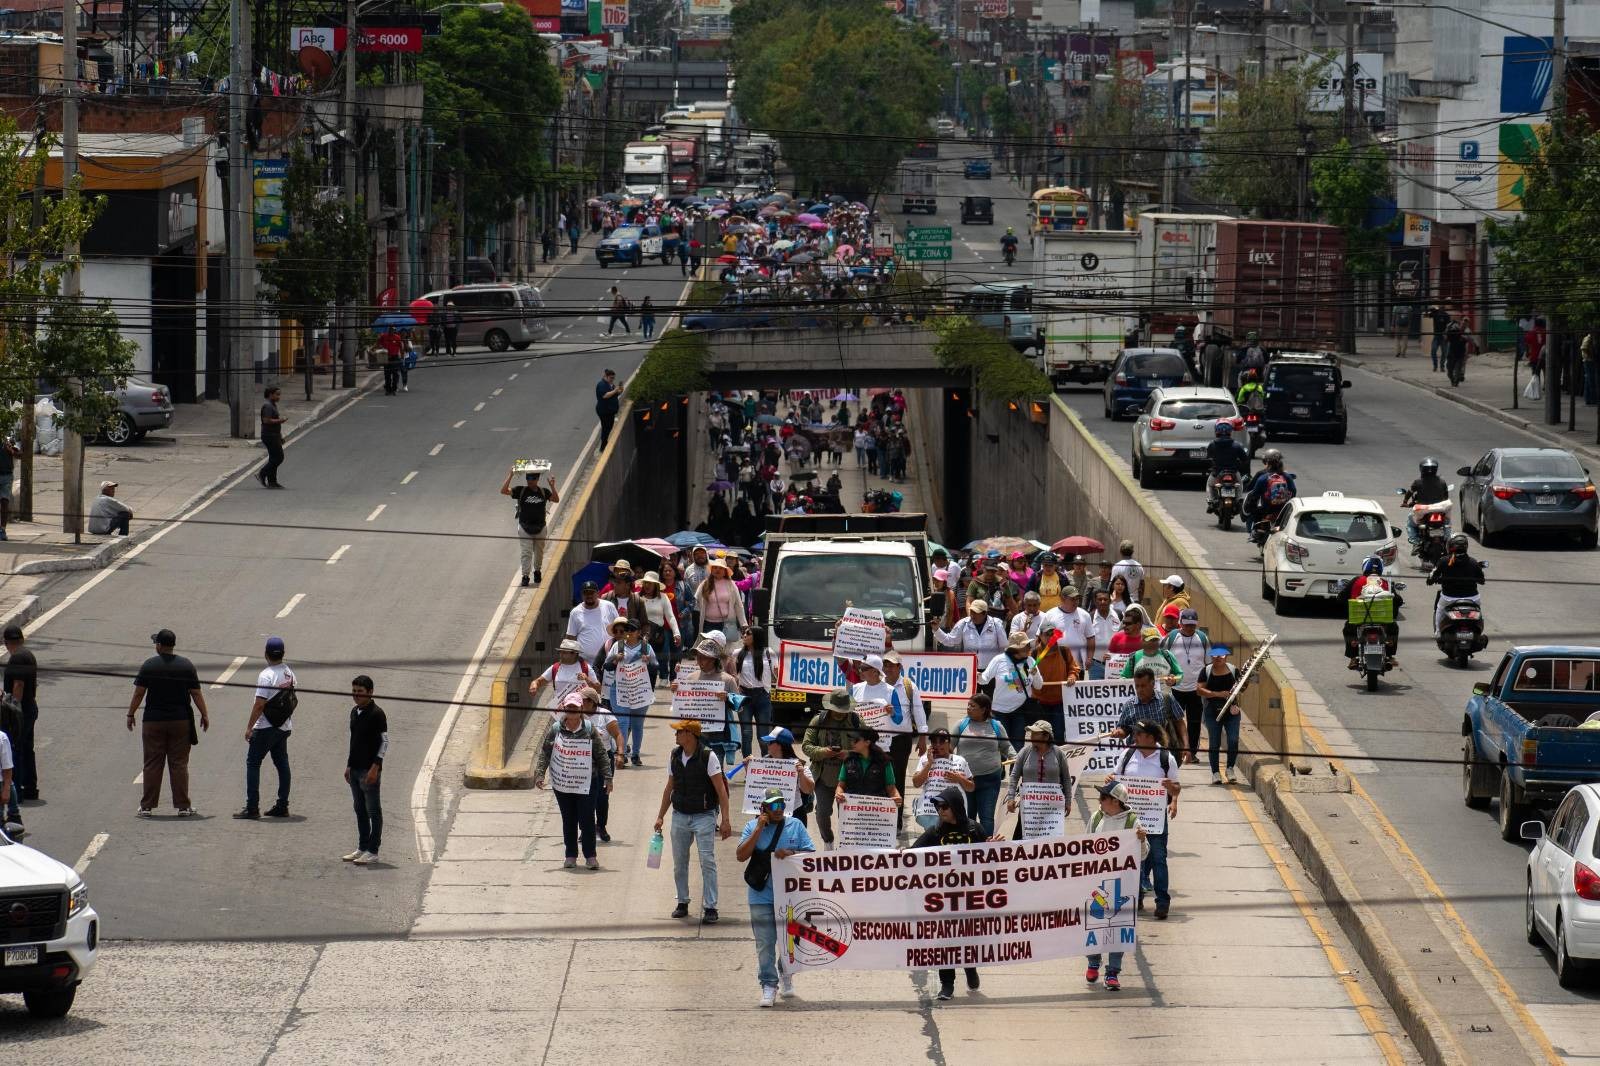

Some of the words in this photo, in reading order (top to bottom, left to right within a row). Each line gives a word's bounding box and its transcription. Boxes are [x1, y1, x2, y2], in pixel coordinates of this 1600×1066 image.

[604, 8, 626, 24] 1702
[302, 35, 325, 44] ABG
[1464, 144, 1473, 157] P
[922, 249, 941, 258] ZONA
[943, 250, 948, 258] 6
[790, 651, 830, 686] Hasta
[908, 661, 968, 695] siempre
[1075, 684, 1136, 699] NUESTRA
[1078, 721, 1095, 735] ES
[751, 768, 796, 777] RENUNCIE
[844, 805, 897, 814] RENUNCIE
[802, 852, 918, 873] SINDICATO
[924, 851, 952, 868] DE
[957, 836, 1121, 865] TRABAJADOR@S
[784, 877, 812, 893] DE
[818, 878, 846, 894] LA
[851, 868, 975, 892] EDUCACIÓN
[981, 869, 1009, 887] DE
[1014, 855, 1138, 882] GUATEMALA
[923, 888, 1009, 913] STEG
[852, 920, 916, 941] SECCIONAL
[917, 916, 1002, 941] DEPARTAMENTO
[1004, 915, 1018, 934] DE
[1020, 907, 1082, 933] GUATEMALA
[906, 945, 962, 968] PRESENTE
[964, 944, 980, 964] EN
[981, 942, 996, 963] LA
[997, 940, 1033, 962] LUCHA
